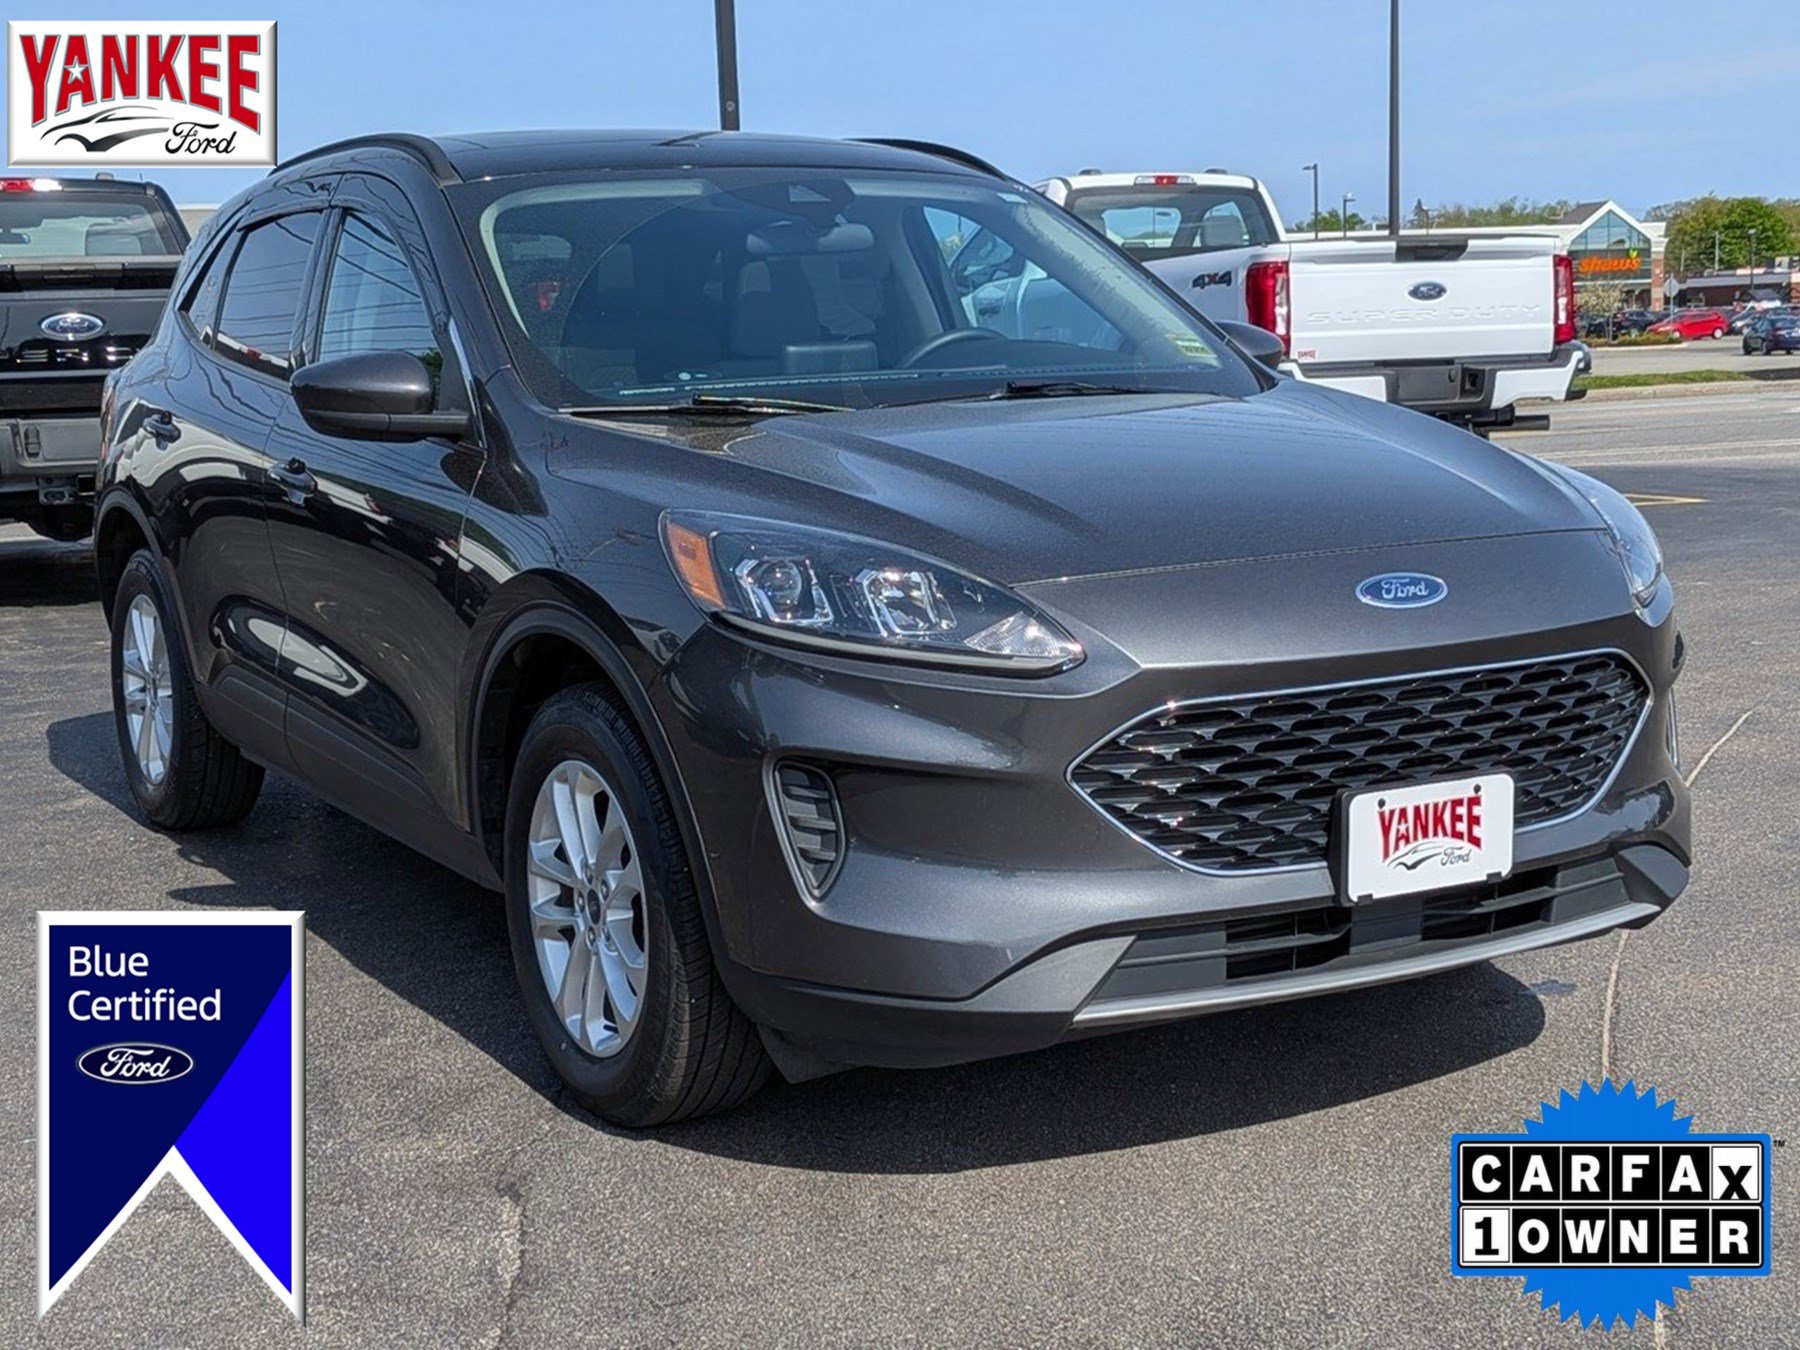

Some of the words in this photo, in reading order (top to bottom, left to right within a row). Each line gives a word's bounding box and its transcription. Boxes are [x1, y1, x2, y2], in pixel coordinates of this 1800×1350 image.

[1308, 308, 1437, 325] SUPER
[1449, 304, 1541, 319] DUTY
[1380, 577, 1430, 599] Ford
[1377, 795, 1483, 863] YANKEE
[1440, 846, 1473, 867] Ford
